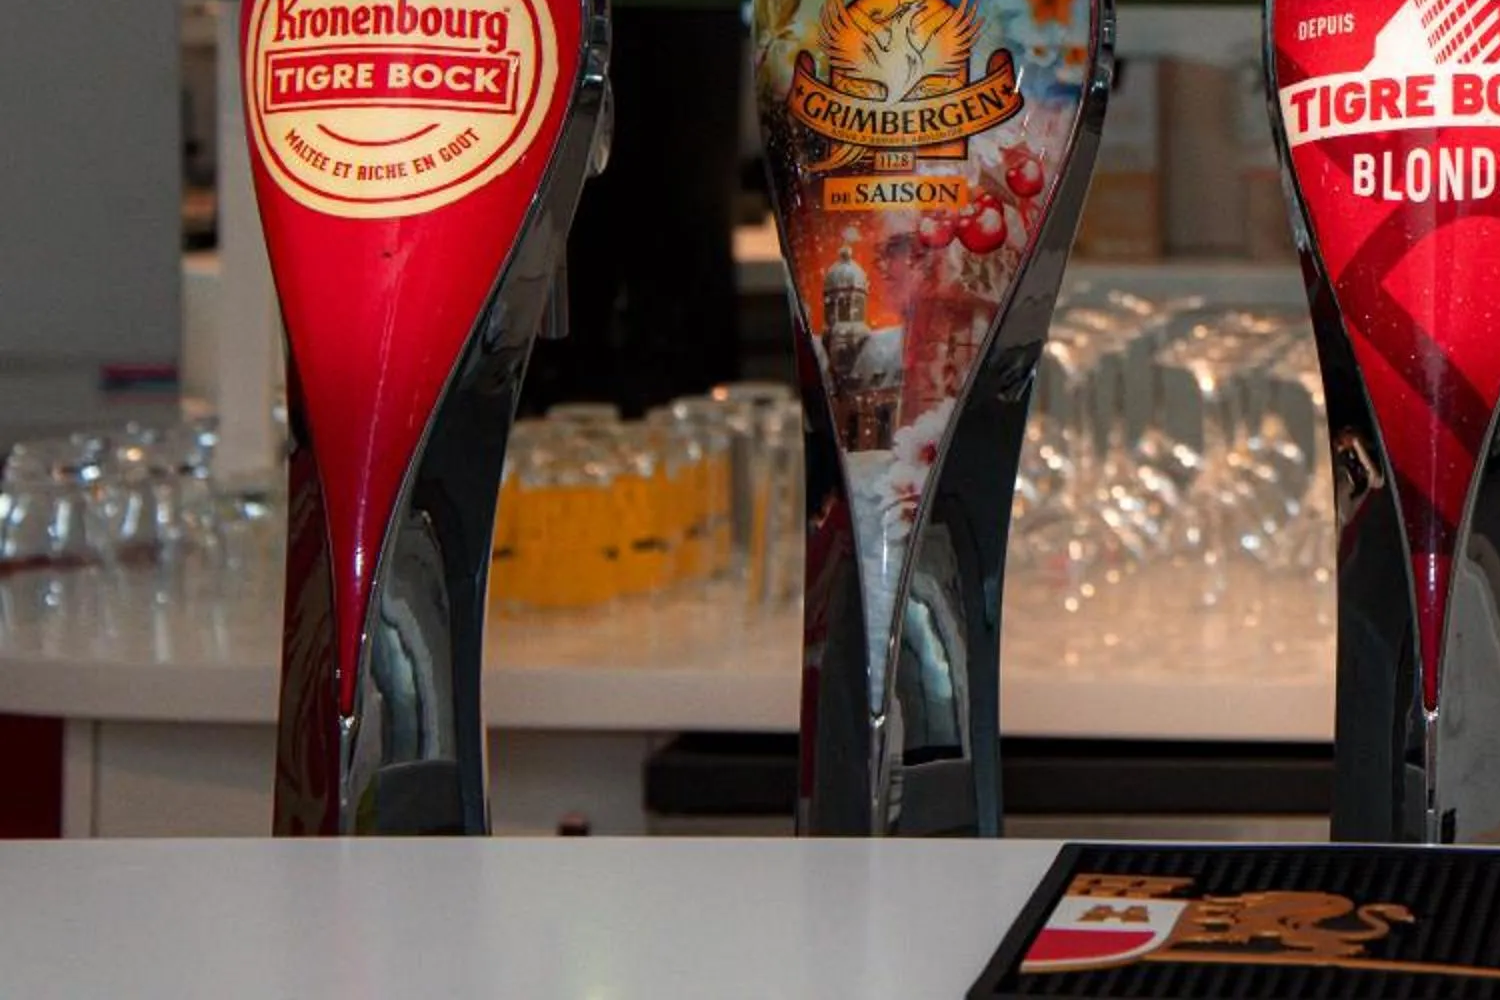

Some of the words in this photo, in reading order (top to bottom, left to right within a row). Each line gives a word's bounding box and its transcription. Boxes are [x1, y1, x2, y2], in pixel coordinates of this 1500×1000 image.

[1298, 13, 1355, 41] DEPUIS
[273, 63, 375, 95] TIGRE
[387, 62, 501, 94] BOCK
[802, 87, 1007, 136] GRIMBERGEN
[1289, 75, 1436, 134] TIGRE
[332, 160, 353, 179] ET
[356, 161, 409, 181] RICHE
[411, 153, 437, 175] EN
[854, 181, 960, 204] SAISON
